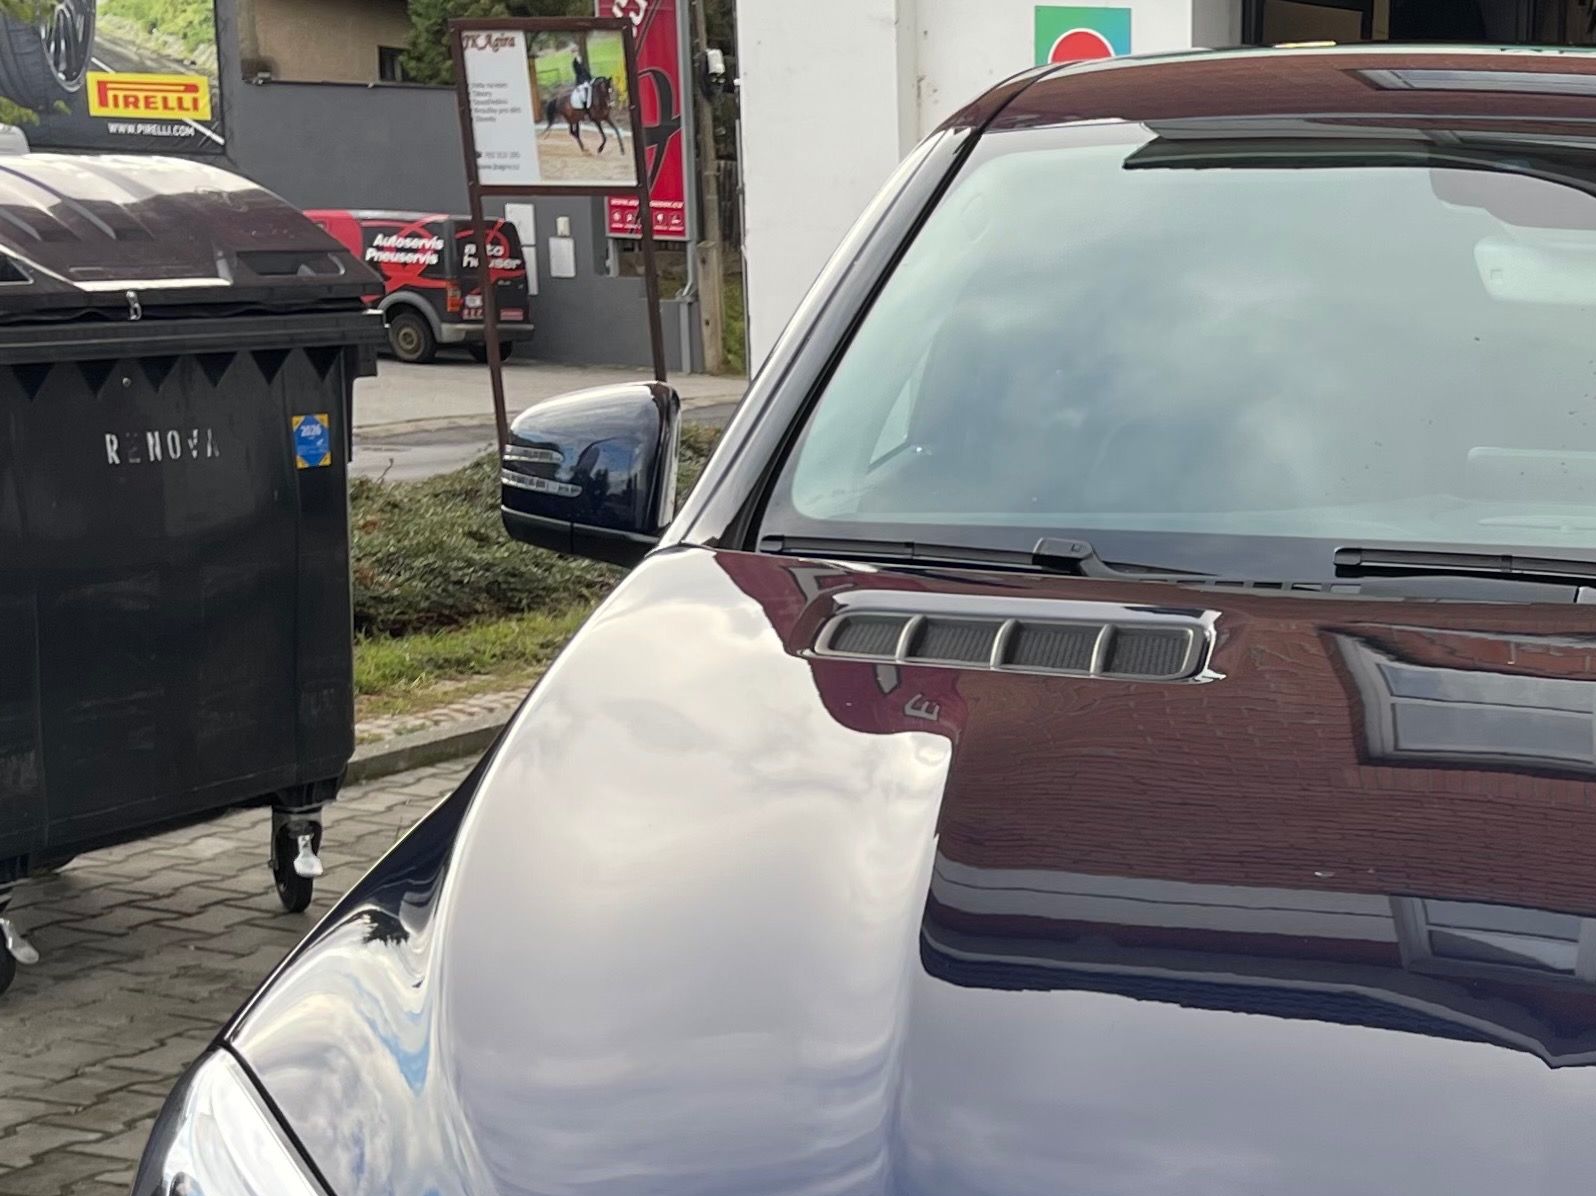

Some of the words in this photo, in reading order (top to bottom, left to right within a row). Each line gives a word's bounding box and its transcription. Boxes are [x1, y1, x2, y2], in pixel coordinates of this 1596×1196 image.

[97, 80, 199, 112] PIRELLI
[107, 123, 195, 137] WWW.PIRELLI.COM
[373, 233, 444, 250] Autoservis
[365, 247, 438, 265] Pneuservis
[105, 428, 219, 465] RNOVA
